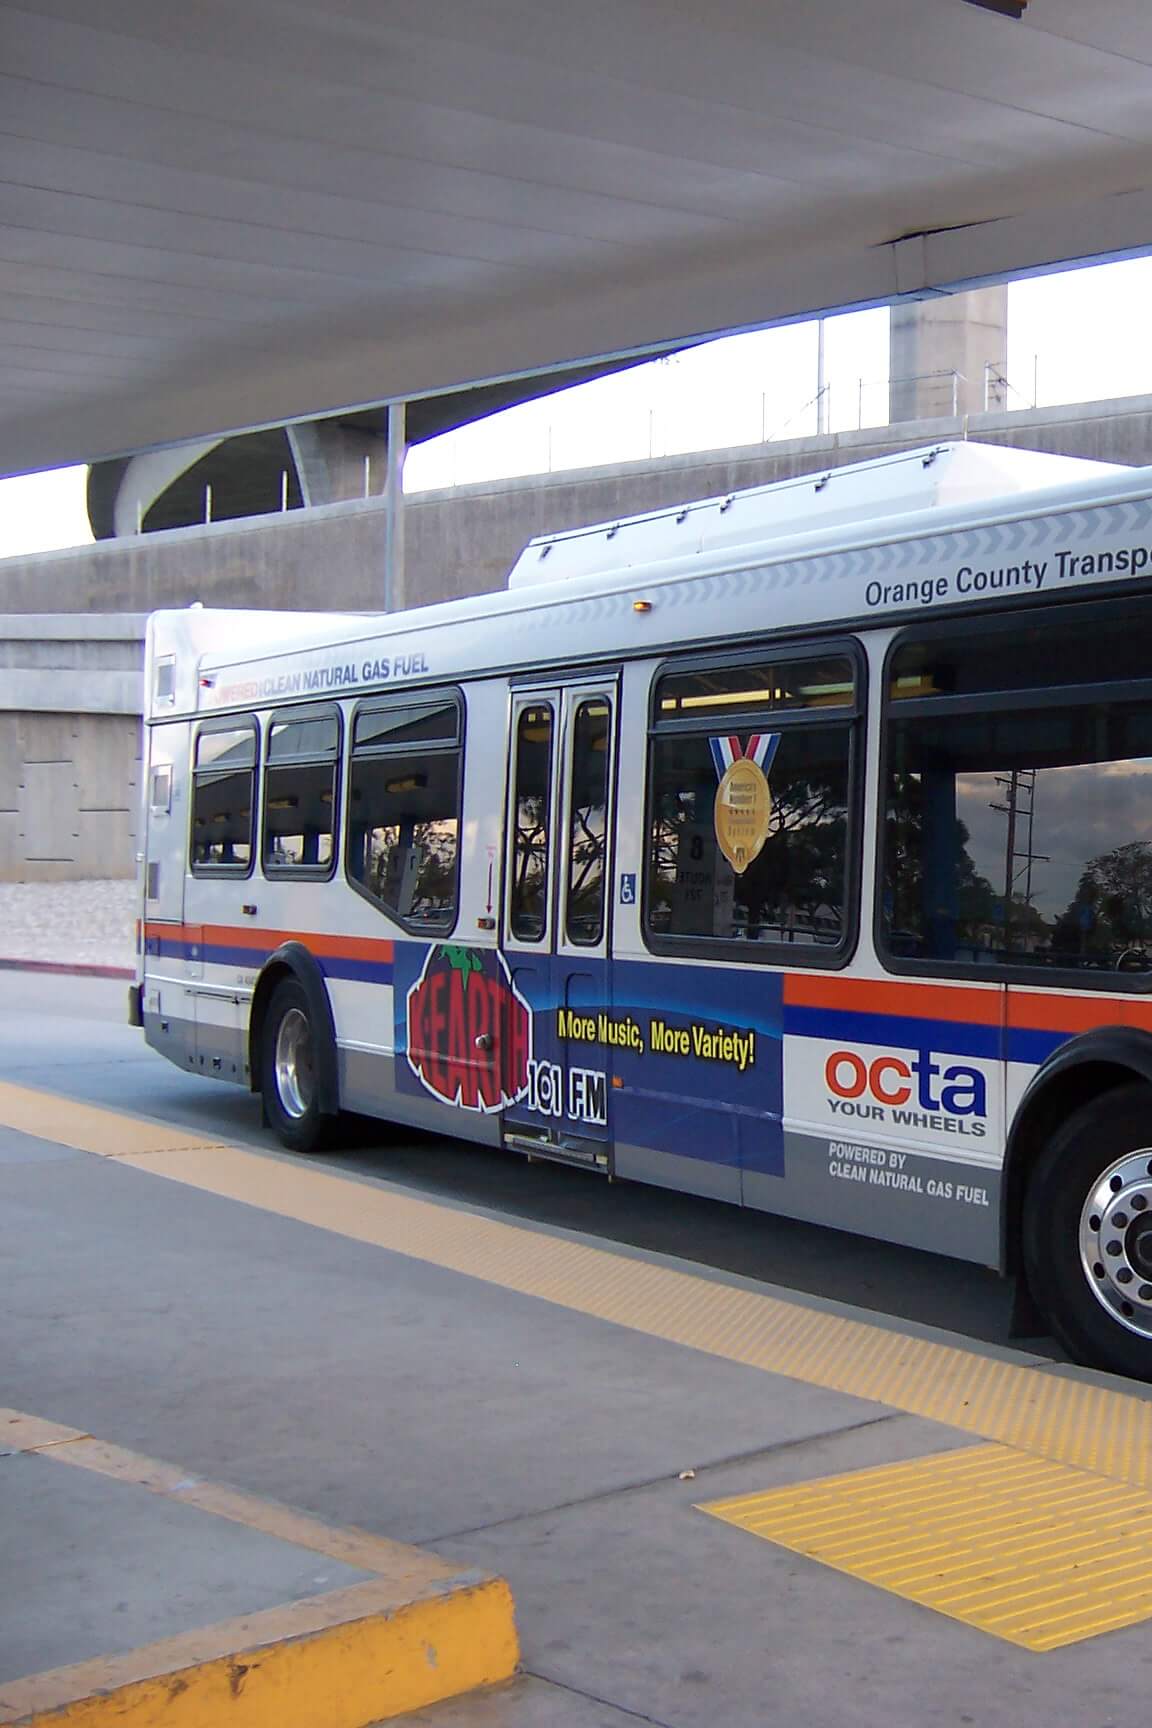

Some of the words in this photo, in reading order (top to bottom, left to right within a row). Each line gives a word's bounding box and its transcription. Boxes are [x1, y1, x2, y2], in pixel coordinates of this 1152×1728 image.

[865, 577, 948, 606] Orange
[956, 560, 1048, 594] County
[264, 672, 300, 697] CLEAN
[303, 664, 358, 689] NATURAL
[362, 656, 390, 681] GAS
[393, 652, 430, 677] FUEL
[558, 1009, 596, 1041] More
[651, 1020, 690, 1054] More
[692, 1025, 755, 1070] Variety!
[527, 1060, 563, 1117] 101
[567, 1066, 608, 1126] FM
[827, 1098, 885, 1121] YOUR
[892, 1109, 987, 1137] WHEELS
[829, 1142, 886, 1165] POWERED
[889, 1153, 906, 1169] BY
[829, 1161, 867, 1183] CLEAN
[869, 1168, 924, 1193] NATURAL
[926, 1179, 953, 1199] GAS
[956, 1184, 989, 1206] FUEL
